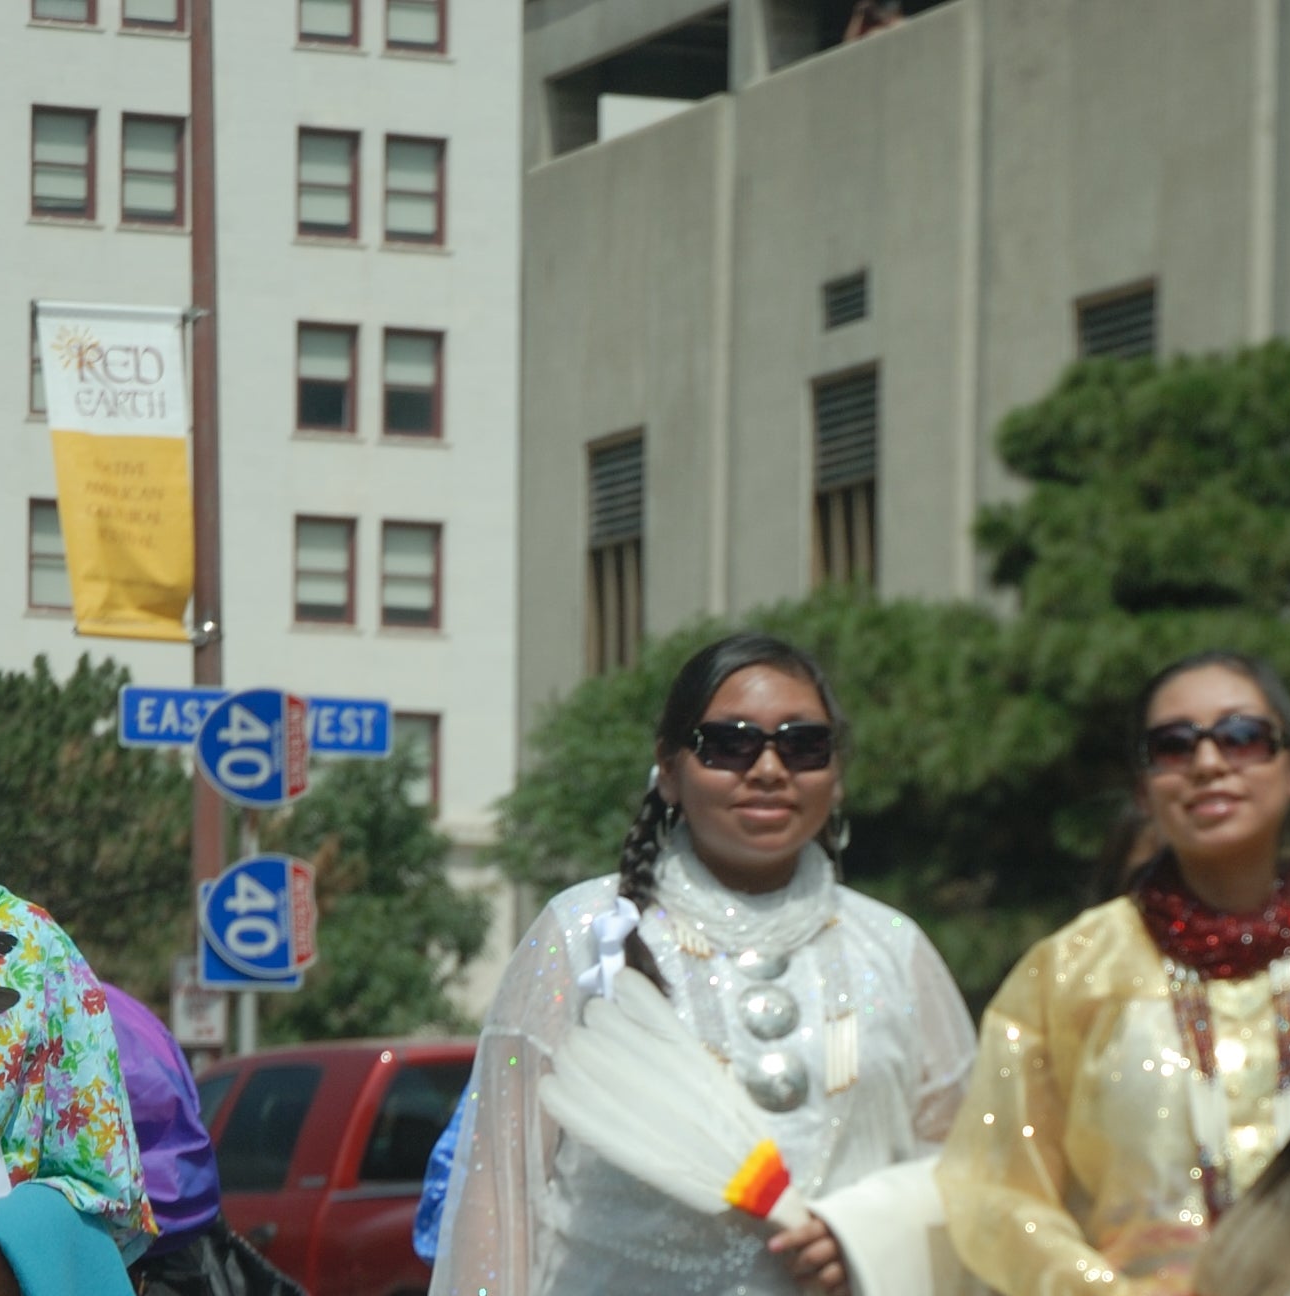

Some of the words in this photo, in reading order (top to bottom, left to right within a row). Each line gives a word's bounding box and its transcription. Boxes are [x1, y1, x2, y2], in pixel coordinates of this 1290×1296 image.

[76, 343, 165, 385] RED
[74, 389, 166, 419] EARTH
[216, 703, 272, 789] 40
[223, 872, 278, 957] 40
